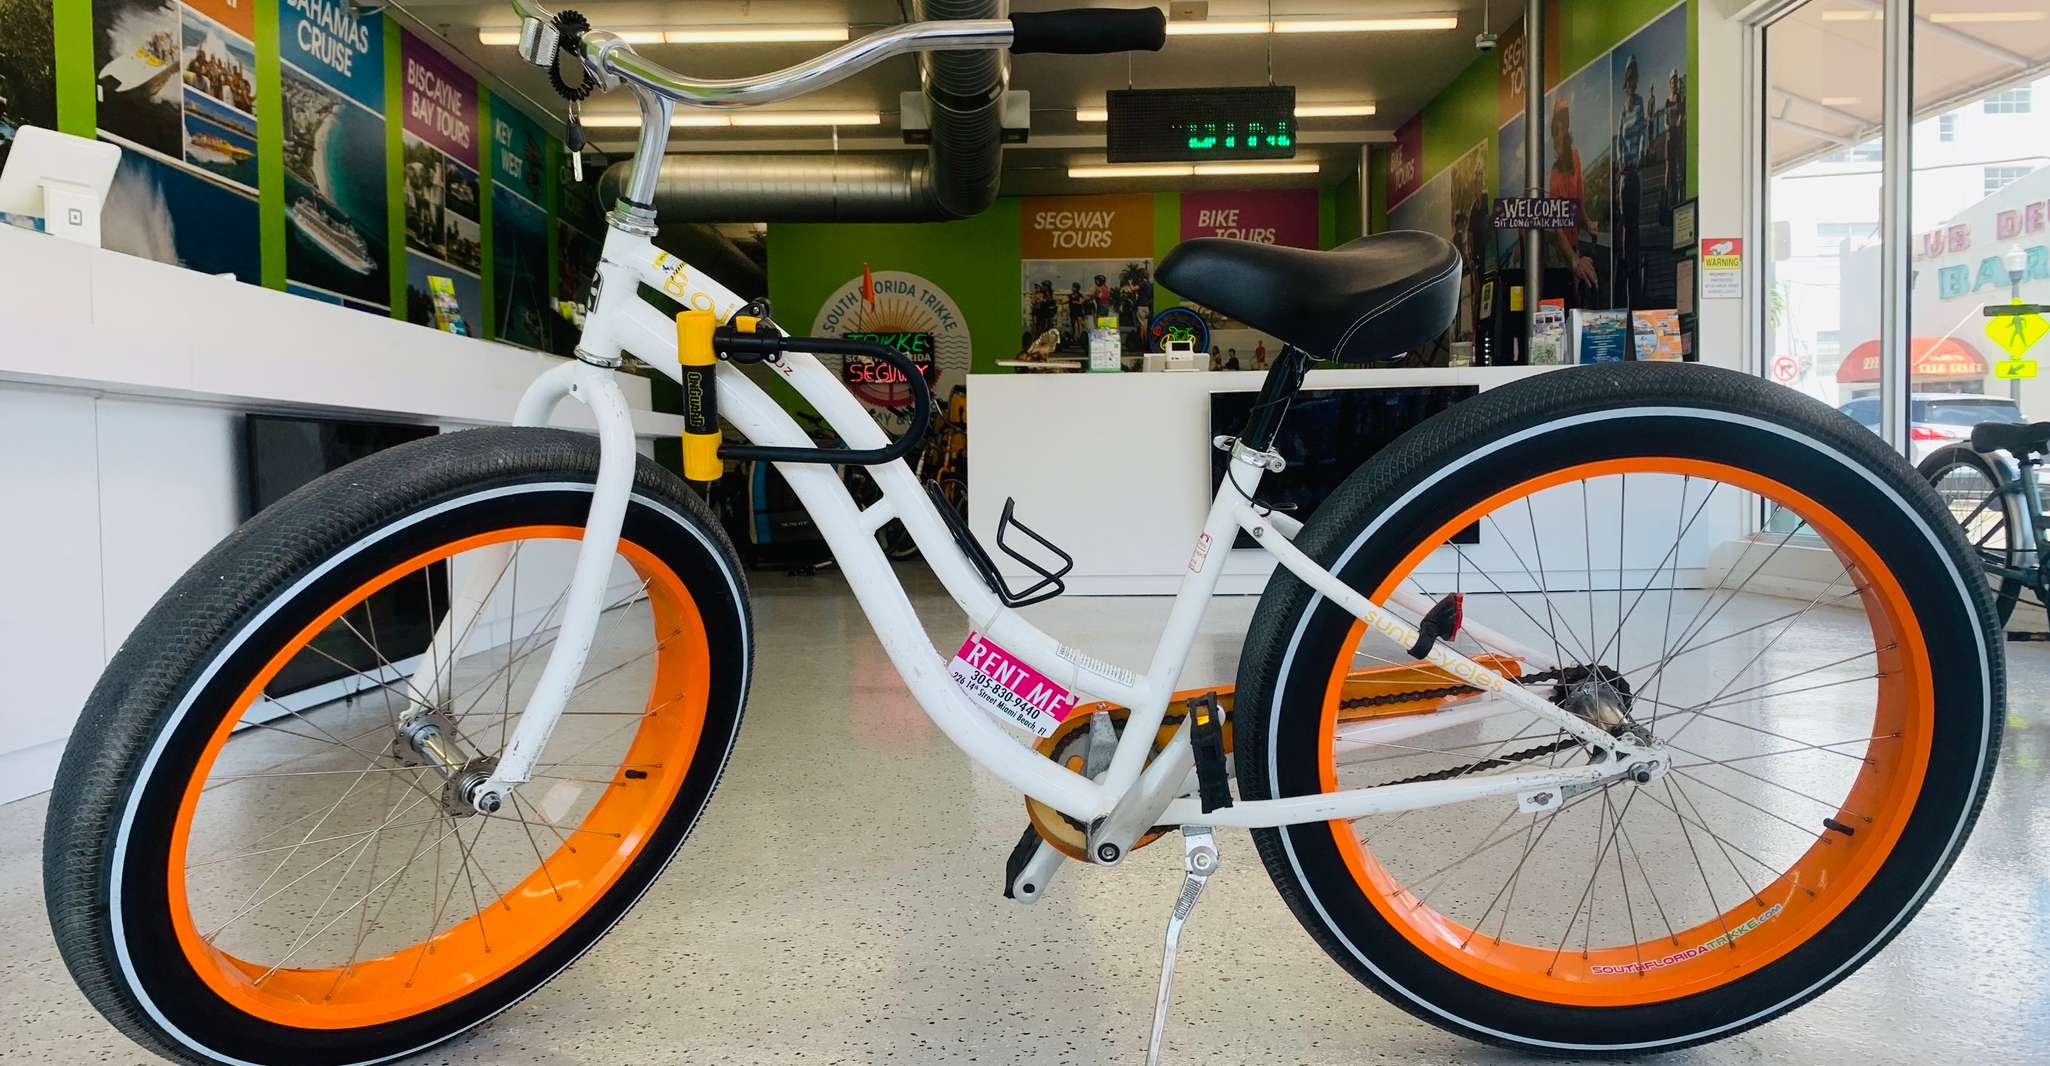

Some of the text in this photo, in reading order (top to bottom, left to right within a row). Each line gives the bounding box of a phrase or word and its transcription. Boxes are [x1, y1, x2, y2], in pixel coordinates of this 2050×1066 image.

[297, 19, 353, 78] CRUISE
[1502, 36, 1528, 76] SEG
[407, 59, 463, 117] BISCAYNE
[411, 91, 471, 149] BAY TOURS
[495, 117, 514, 148] KEY
[500, 148, 524, 180] WEST
[1034, 211, 1116, 230] SEGWAY
[1198, 209, 1240, 228] BIKE
[1502, 199, 1570, 219] WELCOME
[1552, 217, 1574, 228] MUCH
[1996, 198, 2050, 241] DE
[1052, 230, 1113, 249] TOURS
[1705, 257, 1739, 267] WARNING
[823, 280, 958, 333] SOUTH FORIDA TRIKKE
[849, 363, 929, 383] SEGWY
[966, 642, 1068, 718] RENT ME
[971, 670, 1041, 720] 305-830-9440
[952, 671, 965, 685] 226
[966, 680, 979, 691] 14th
[978, 688, 998, 705] Street
[997, 700, 1017, 718] Miami
[1017, 712, 1037, 732] Beach,
